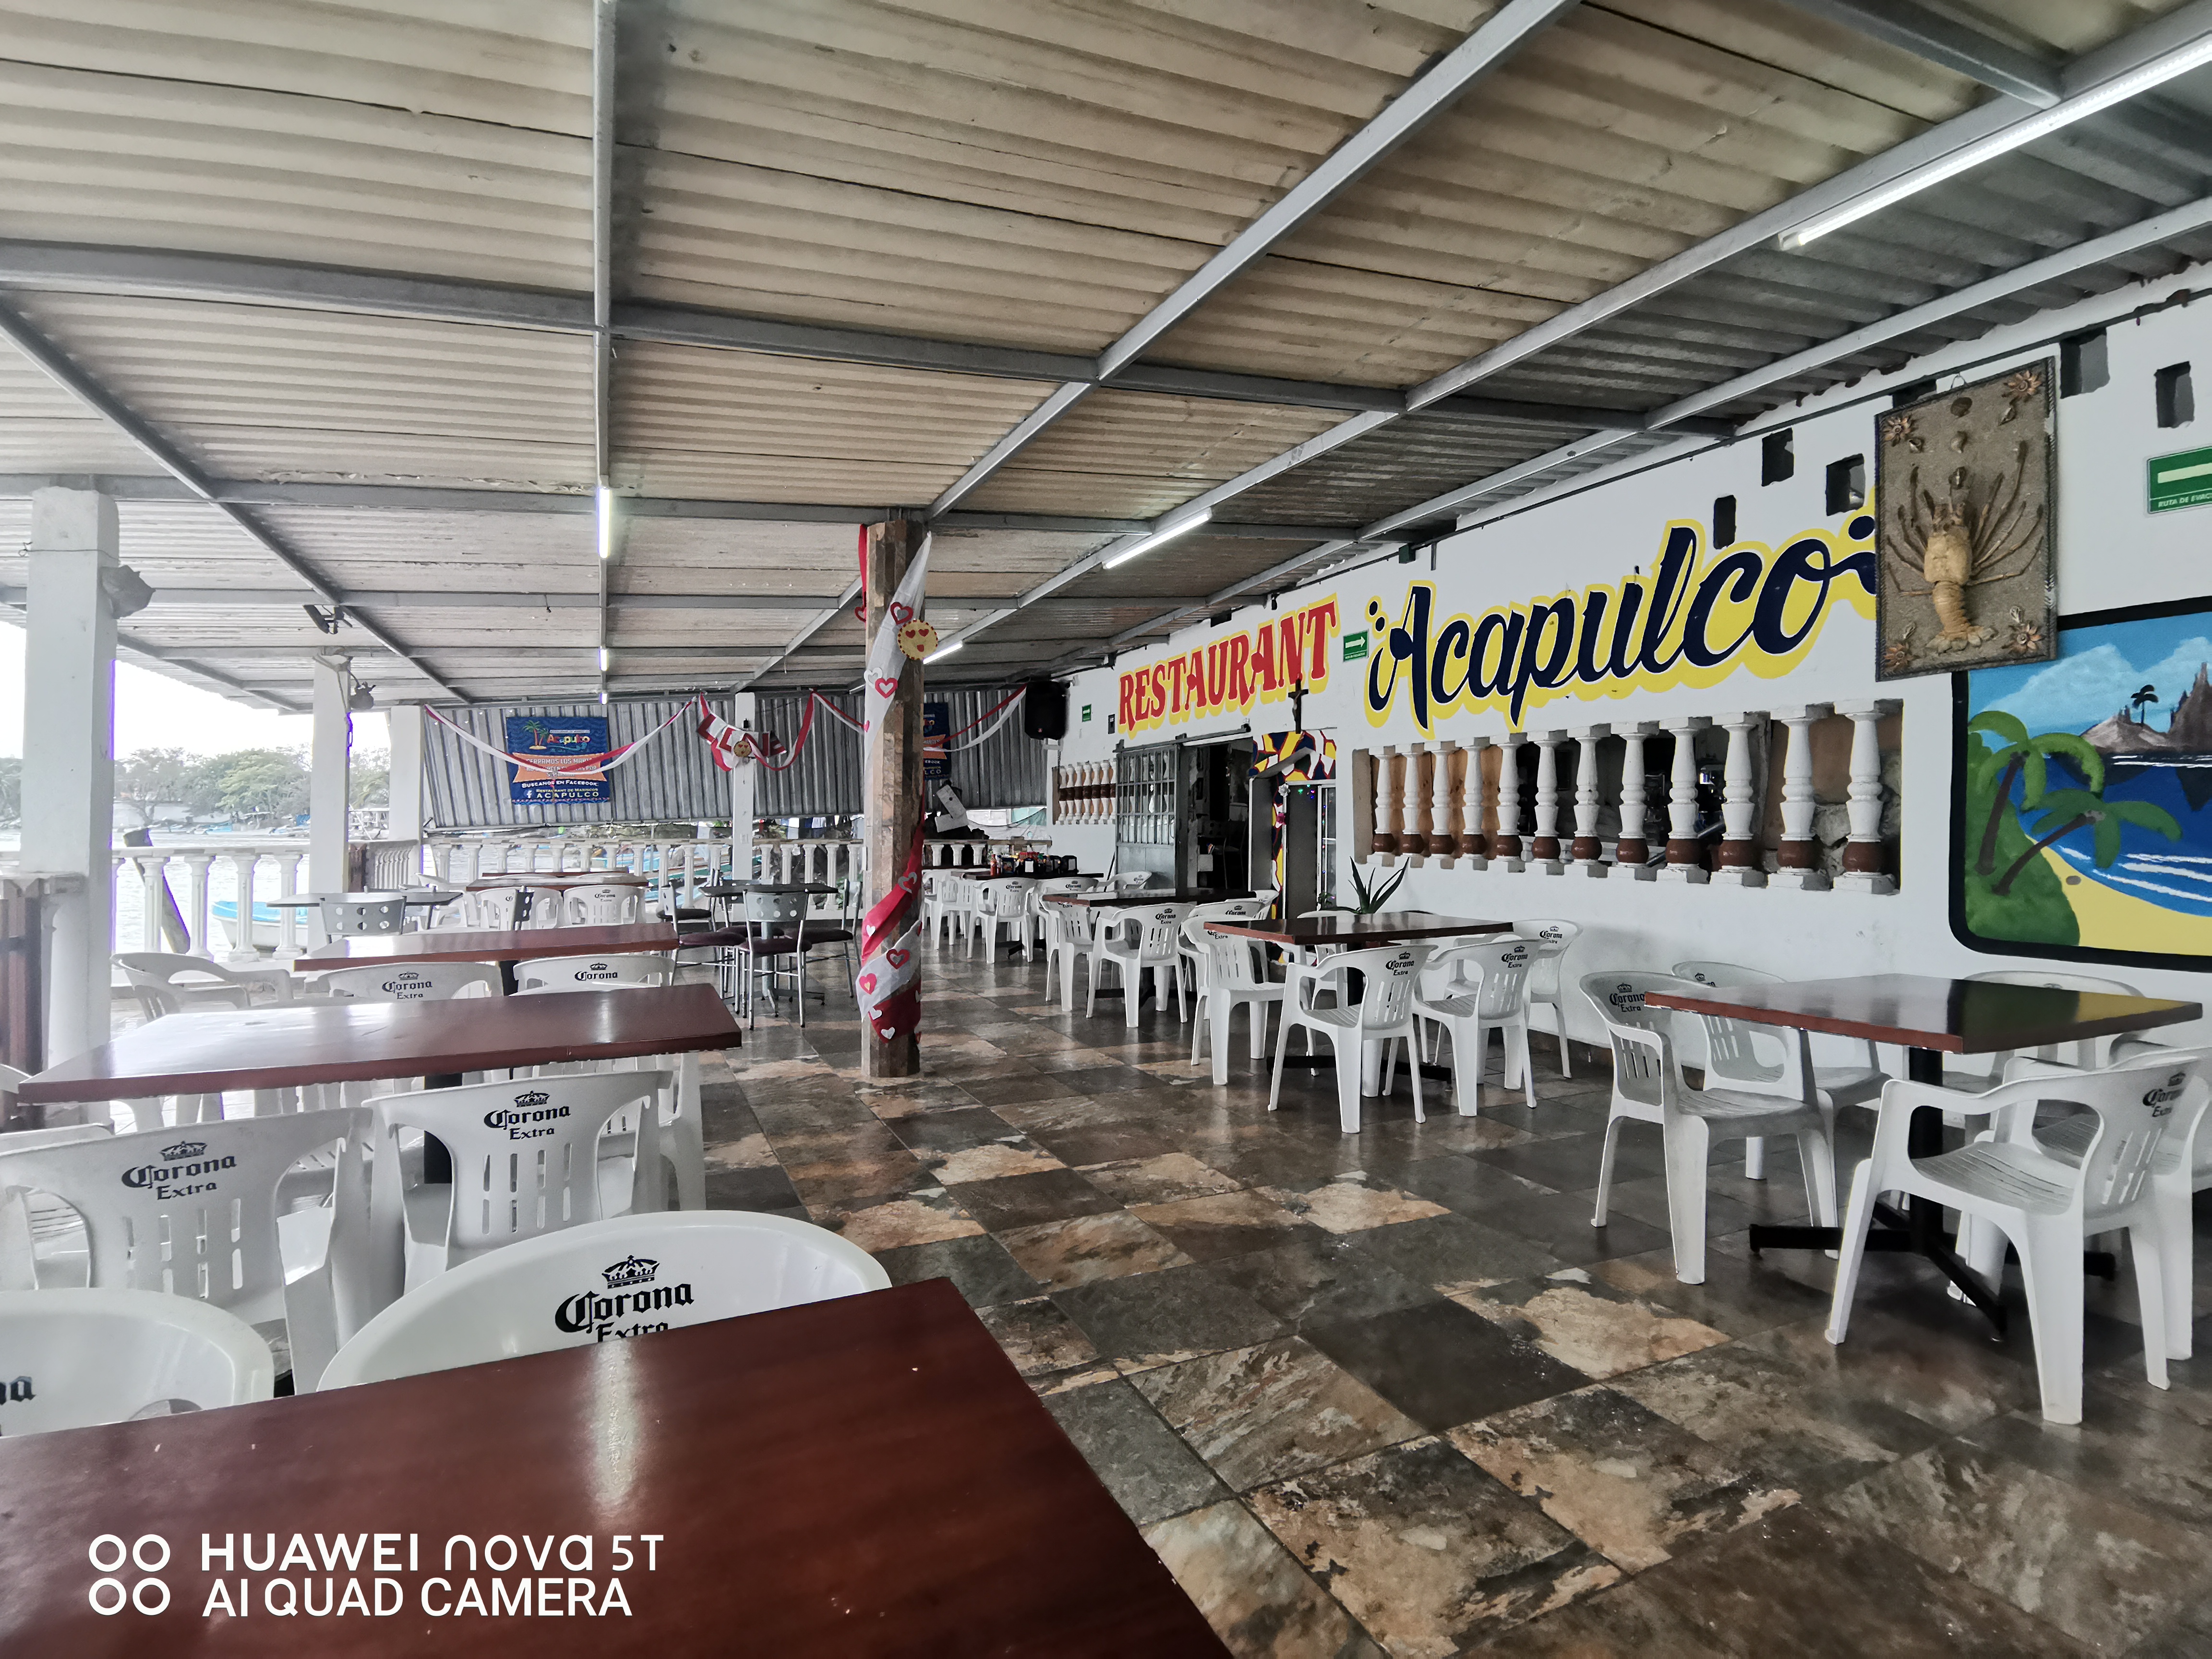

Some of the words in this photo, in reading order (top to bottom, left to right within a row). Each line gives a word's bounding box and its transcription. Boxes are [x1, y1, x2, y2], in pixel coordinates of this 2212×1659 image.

[2158, 499, 2178, 508] RUTA
[1369, 526, 1875, 730] Acapulco
[1119, 601, 1336, 731] RESTAURANT
[1539, 930, 1563, 939] Corona
[1502, 953, 1528, 963] Corona
[1385, 960, 1415, 970] Corona
[575, 971, 618, 981] Corona
[382, 981, 433, 994] Corona
[1610, 993, 1646, 1007] Corona
[1620, 1004, 1641, 1012] Extra
[484, 1105, 571, 1130] Corona
[509, 1127, 555, 1140] Extra
[121, 1154, 237, 1189] Corona
[156, 1180, 217, 1200] Extra
[554, 1283, 694, 1334] Corona
